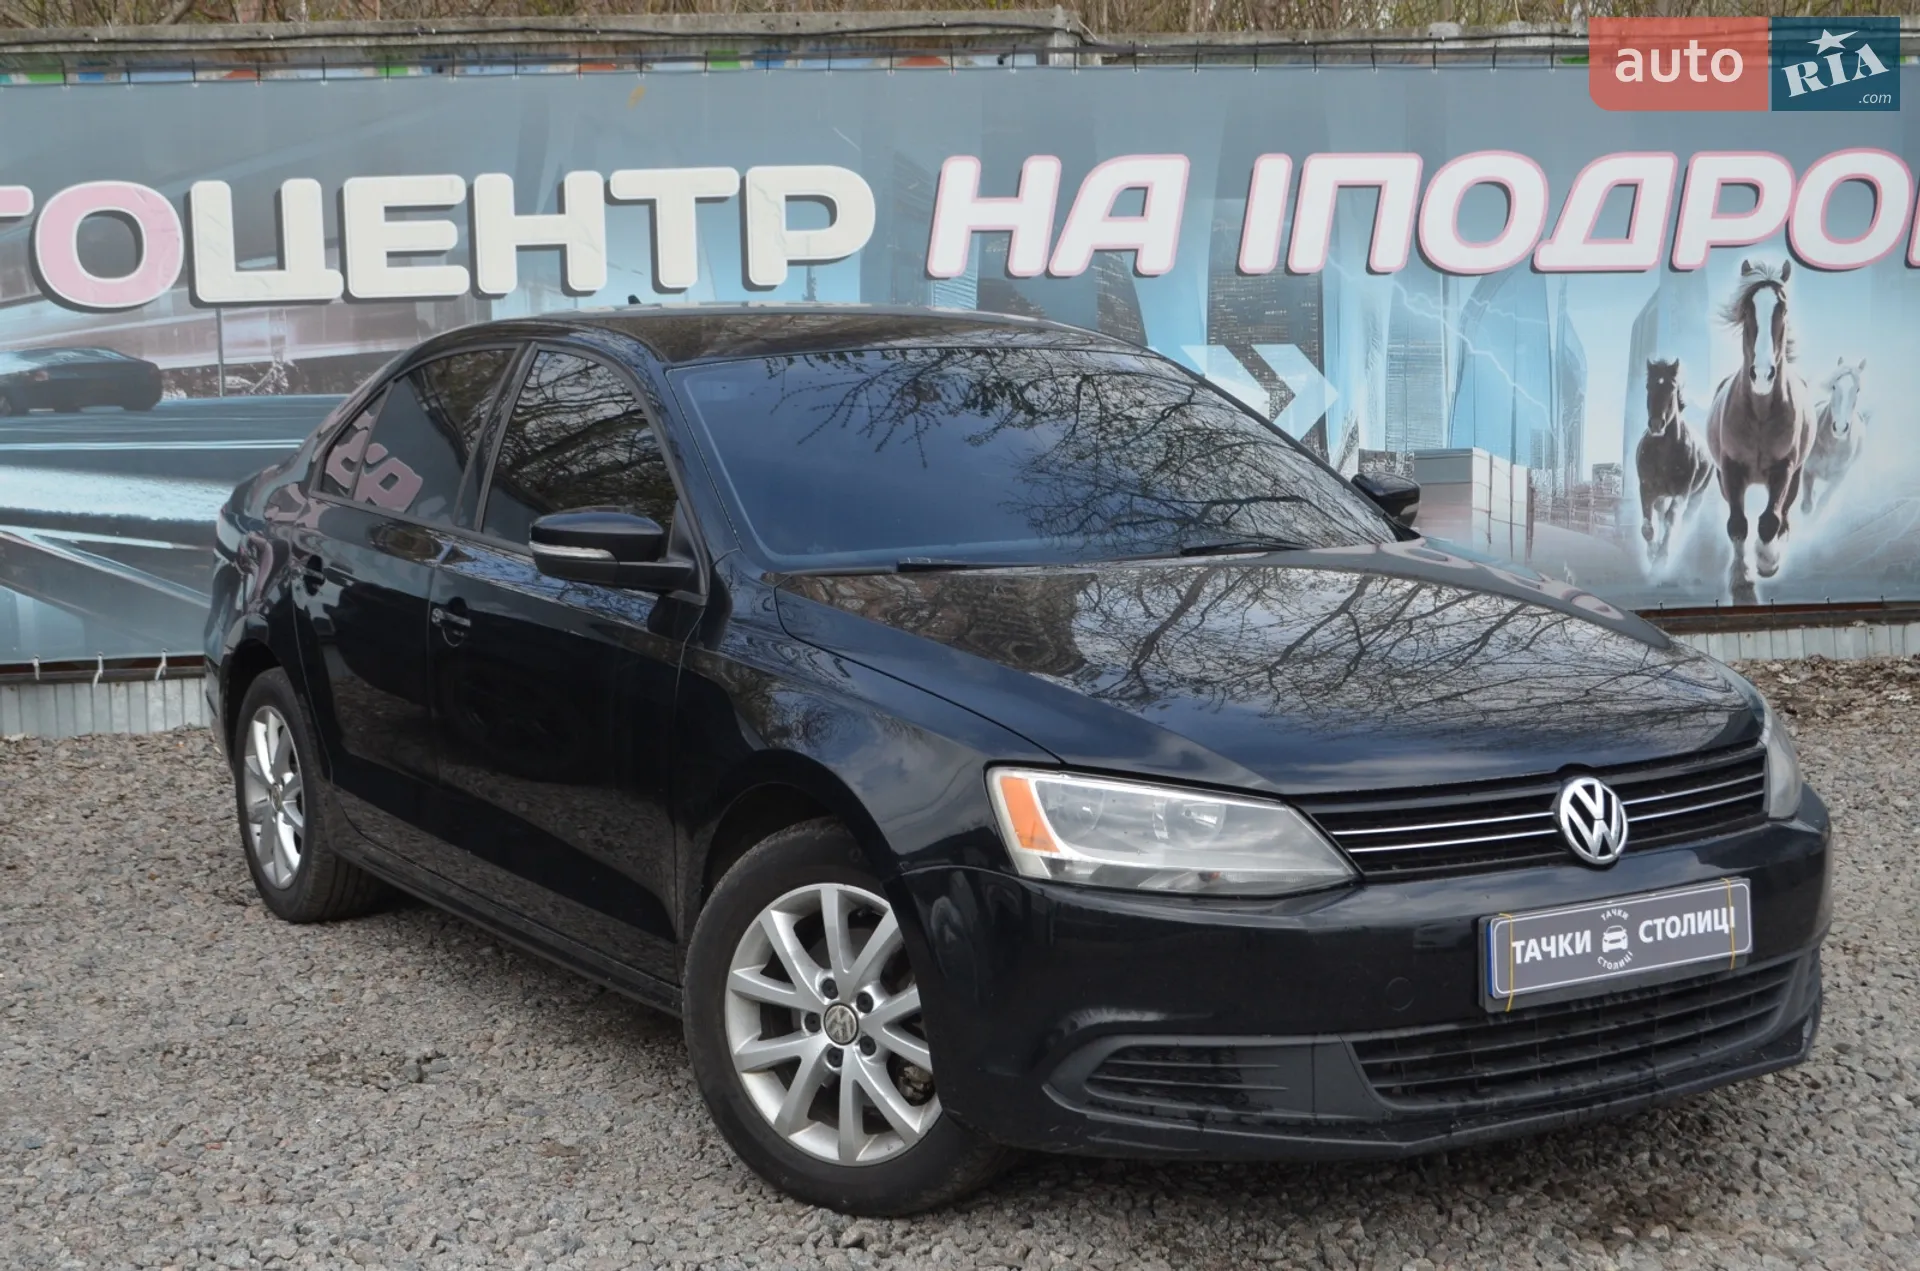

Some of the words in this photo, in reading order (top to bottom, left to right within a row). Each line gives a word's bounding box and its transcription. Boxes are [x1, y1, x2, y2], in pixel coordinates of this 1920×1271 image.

[927, 153, 1190, 278] НА
[1238, 147, 1920, 276] ІПОДРО
[1560, 777, 1628, 865] VW
[1512, 929, 1592, 965] ТАЧКИ
[1638, 906, 1736, 944] СТОЛИЦІ
[1601, 908, 1629, 921] ТАЧКИ
